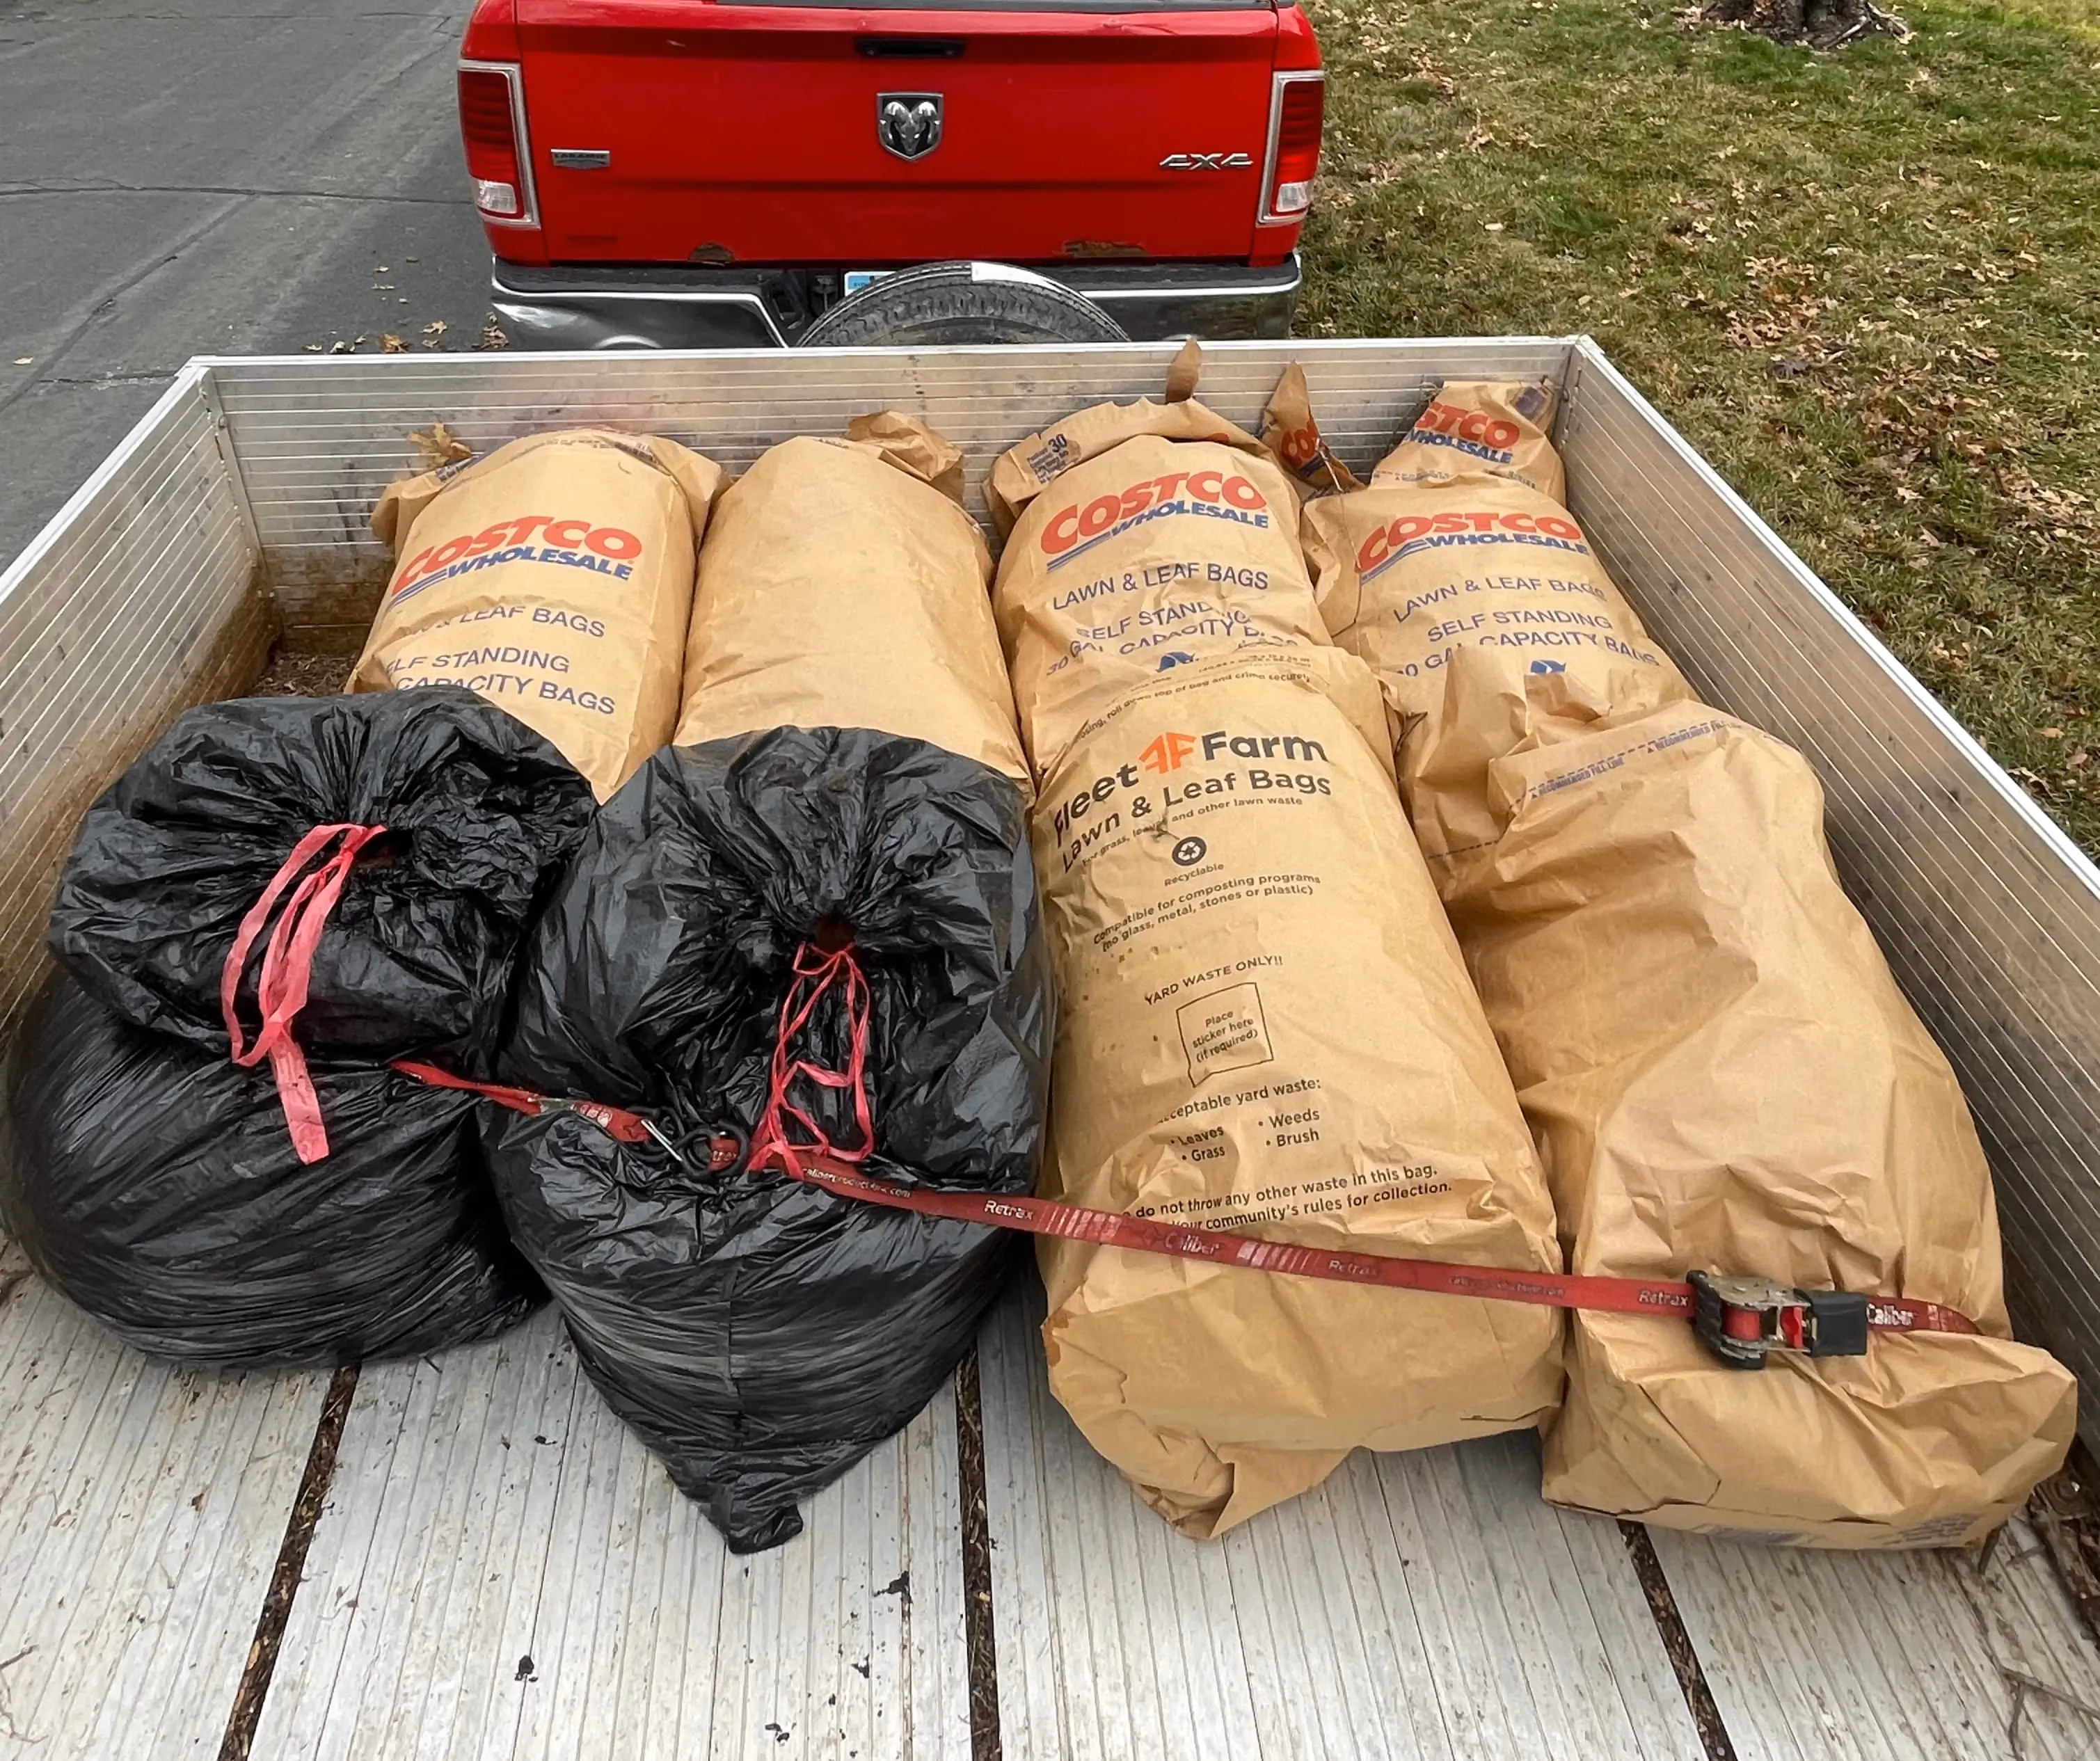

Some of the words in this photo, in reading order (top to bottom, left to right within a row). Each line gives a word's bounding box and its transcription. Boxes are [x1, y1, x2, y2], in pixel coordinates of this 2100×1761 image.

[1048, 433, 1067, 453] 30
[1040, 471, 1268, 554] COSTCO
[1112, 500, 1268, 536] WHOLESALE
[391, 516, 642, 596] COSTCO
[1355, 513, 1582, 573] COSTCO
[1428, 532, 1590, 555] WHOLESALE
[447, 546, 634, 581] WHOLESALE
[1053, 577, 1115, 610] LAWN
[1122, 573, 1138, 591] &
[1143, 562, 1200, 587] LEAF
[1207, 563, 1268, 590] BAGS
[1394, 584, 1458, 623] LAWN
[1465, 579, 1479, 592] &
[1486, 576, 1543, 592] LEAF
[532, 607, 605, 638] BAGS
[1076, 616, 1131, 640] SELF
[1427, 613, 1487, 643] SELF
[1493, 609, 1613, 629] STANDING
[431, 647, 570, 674] STANDING
[1046, 655, 1069, 676] 30
[1397, 663, 1419, 677] 0
[539, 681, 616, 715] BAGS
[1107, 705, 1122, 719] roll
[1212, 674, 1232, 684] and
[1054, 762, 1139, 849] Fleet
[1202, 730, 1330, 763] Farm
[1063, 813, 1120, 875] Lawn
[1131, 795, 1152, 819] &
[1163, 772, 1237, 807] Leaf
[1248, 769, 1332, 796] Bags
[1100, 836, 1131, 857] grass,
[1172, 810, 1195, 822] and
[1198, 800, 1230, 815] other
[1234, 798, 1263, 807] lawn
[1267, 797, 1303, 806] waste
[1164, 862, 1225, 886] Recyclable
[1093, 907, 1154, 945] Compatible
[1158, 898, 1175, 911] for
[1179, 876, 1254, 904] composting
[1258, 874, 1321, 886] programs
[1101, 937, 1119, 953] (no
[1121, 920, 1155, 941] glass,
[1158, 904, 1197, 923] metal,
[1199, 891, 1242, 910] stones
[1246, 888, 1259, 898] or
[1264, 884, 1314, 897] plastic)
[1145, 983, 1179, 1006] YARD
[1182, 965, 1232, 987] WASTE
[1236, 955, 1284, 972] ONLY!!
[1192, 1026, 1227, 1049] sticker
[1230, 1018, 1254, 1032] here
[1205, 1010, 1234, 1028] Place
[1195, 1048, 1208, 1063] (if
[1210, 1029, 1259, 1056] required)
[1157, 1094, 1232, 1124] ceptable
[1236, 1086, 1269, 1106] yard
[1273, 1078, 1322, 1097] waste:
[1178, 1125, 1225, 1146] Leaves
[1268, 1108, 1320, 1129] Weeds
[1191, 1145, 1226, 1162] Grass
[1276, 1128, 1320, 1147] Brush
[1136, 1206, 1156, 1218] do
[1160, 1202, 1184, 1216] not
[1188, 1195, 1223, 1211] throw
[1225, 1192, 1250, 1207] any
[1255, 1185, 1298, 1202] other
[1302, 1176, 1348, 1194] waste
[1352, 1172, 1367, 1186] in
[1370, 1168, 1400, 1184] this
[1403, 1165, 1438, 1179] bag.
[1206, 1204, 1299, 1229] community's
[1304, 1197, 1343, 1215] rules
[1347, 1193, 1369, 1209] for
[1374, 1182, 1452, 1202] collection.
[984, 1199, 1034, 1220] Retrax
[1639, 1289, 1689, 1307] Retrax
